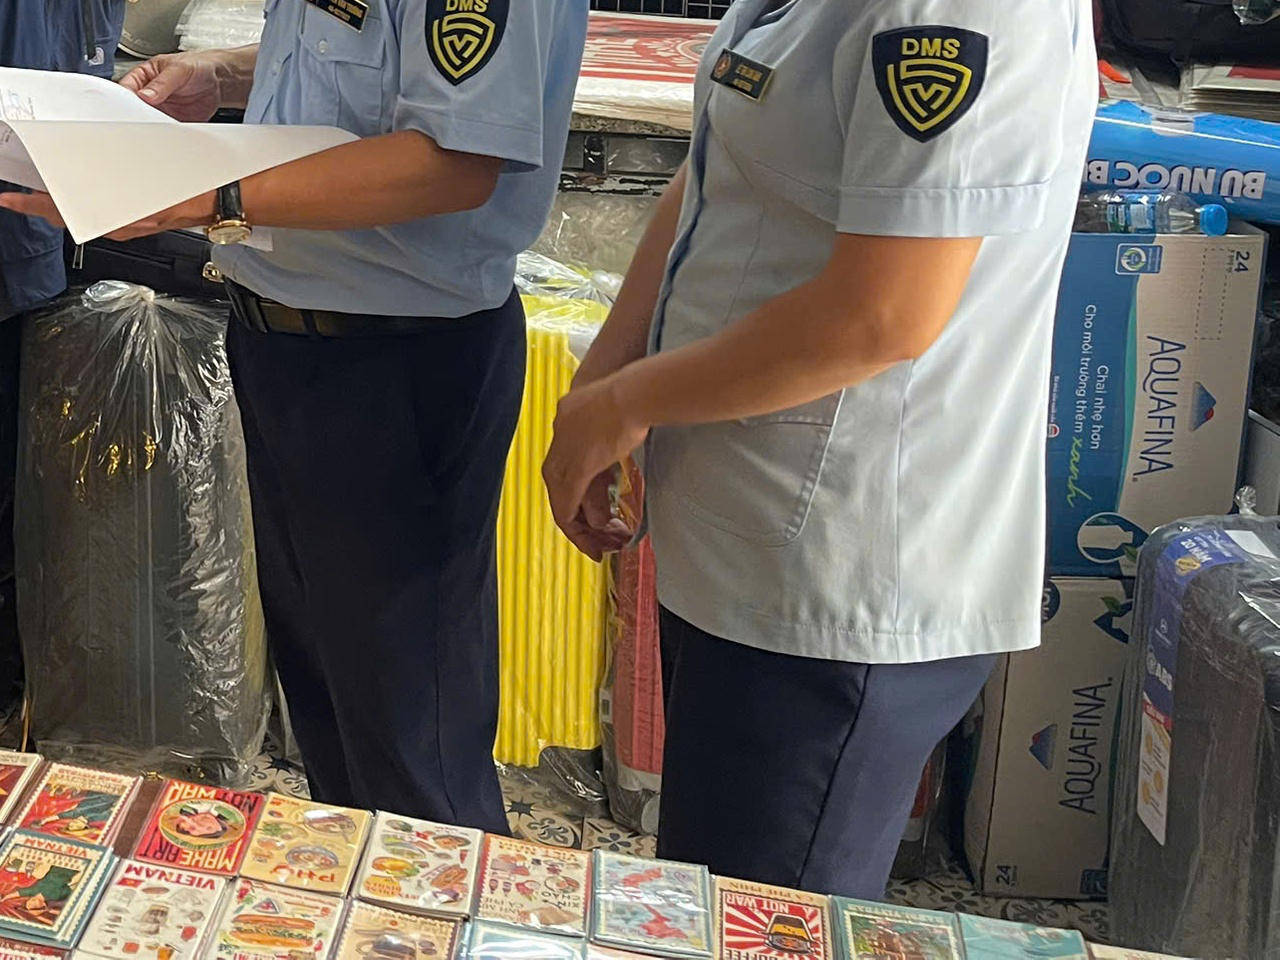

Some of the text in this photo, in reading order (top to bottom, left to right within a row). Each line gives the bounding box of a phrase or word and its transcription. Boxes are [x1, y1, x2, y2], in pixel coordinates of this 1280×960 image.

[901, 38, 961, 60] DMS
[1234, 250, 1250, 273] 24
[1066, 304, 1096, 508] Cho môi trường thêm xanh
[1090, 364, 1110, 450] Chai nhẹ hơn
[1132, 335, 1187, 477] AQUAFINA
[1058, 683, 1112, 815] AQUAFINA
[164, 781, 216, 805] WAR
[22, 838, 88, 858] VIETNAM
[175, 840, 242, 871] MAKE
[124, 863, 216, 891] VIETNAM
[724, 893, 790, 913] NOT WAR
